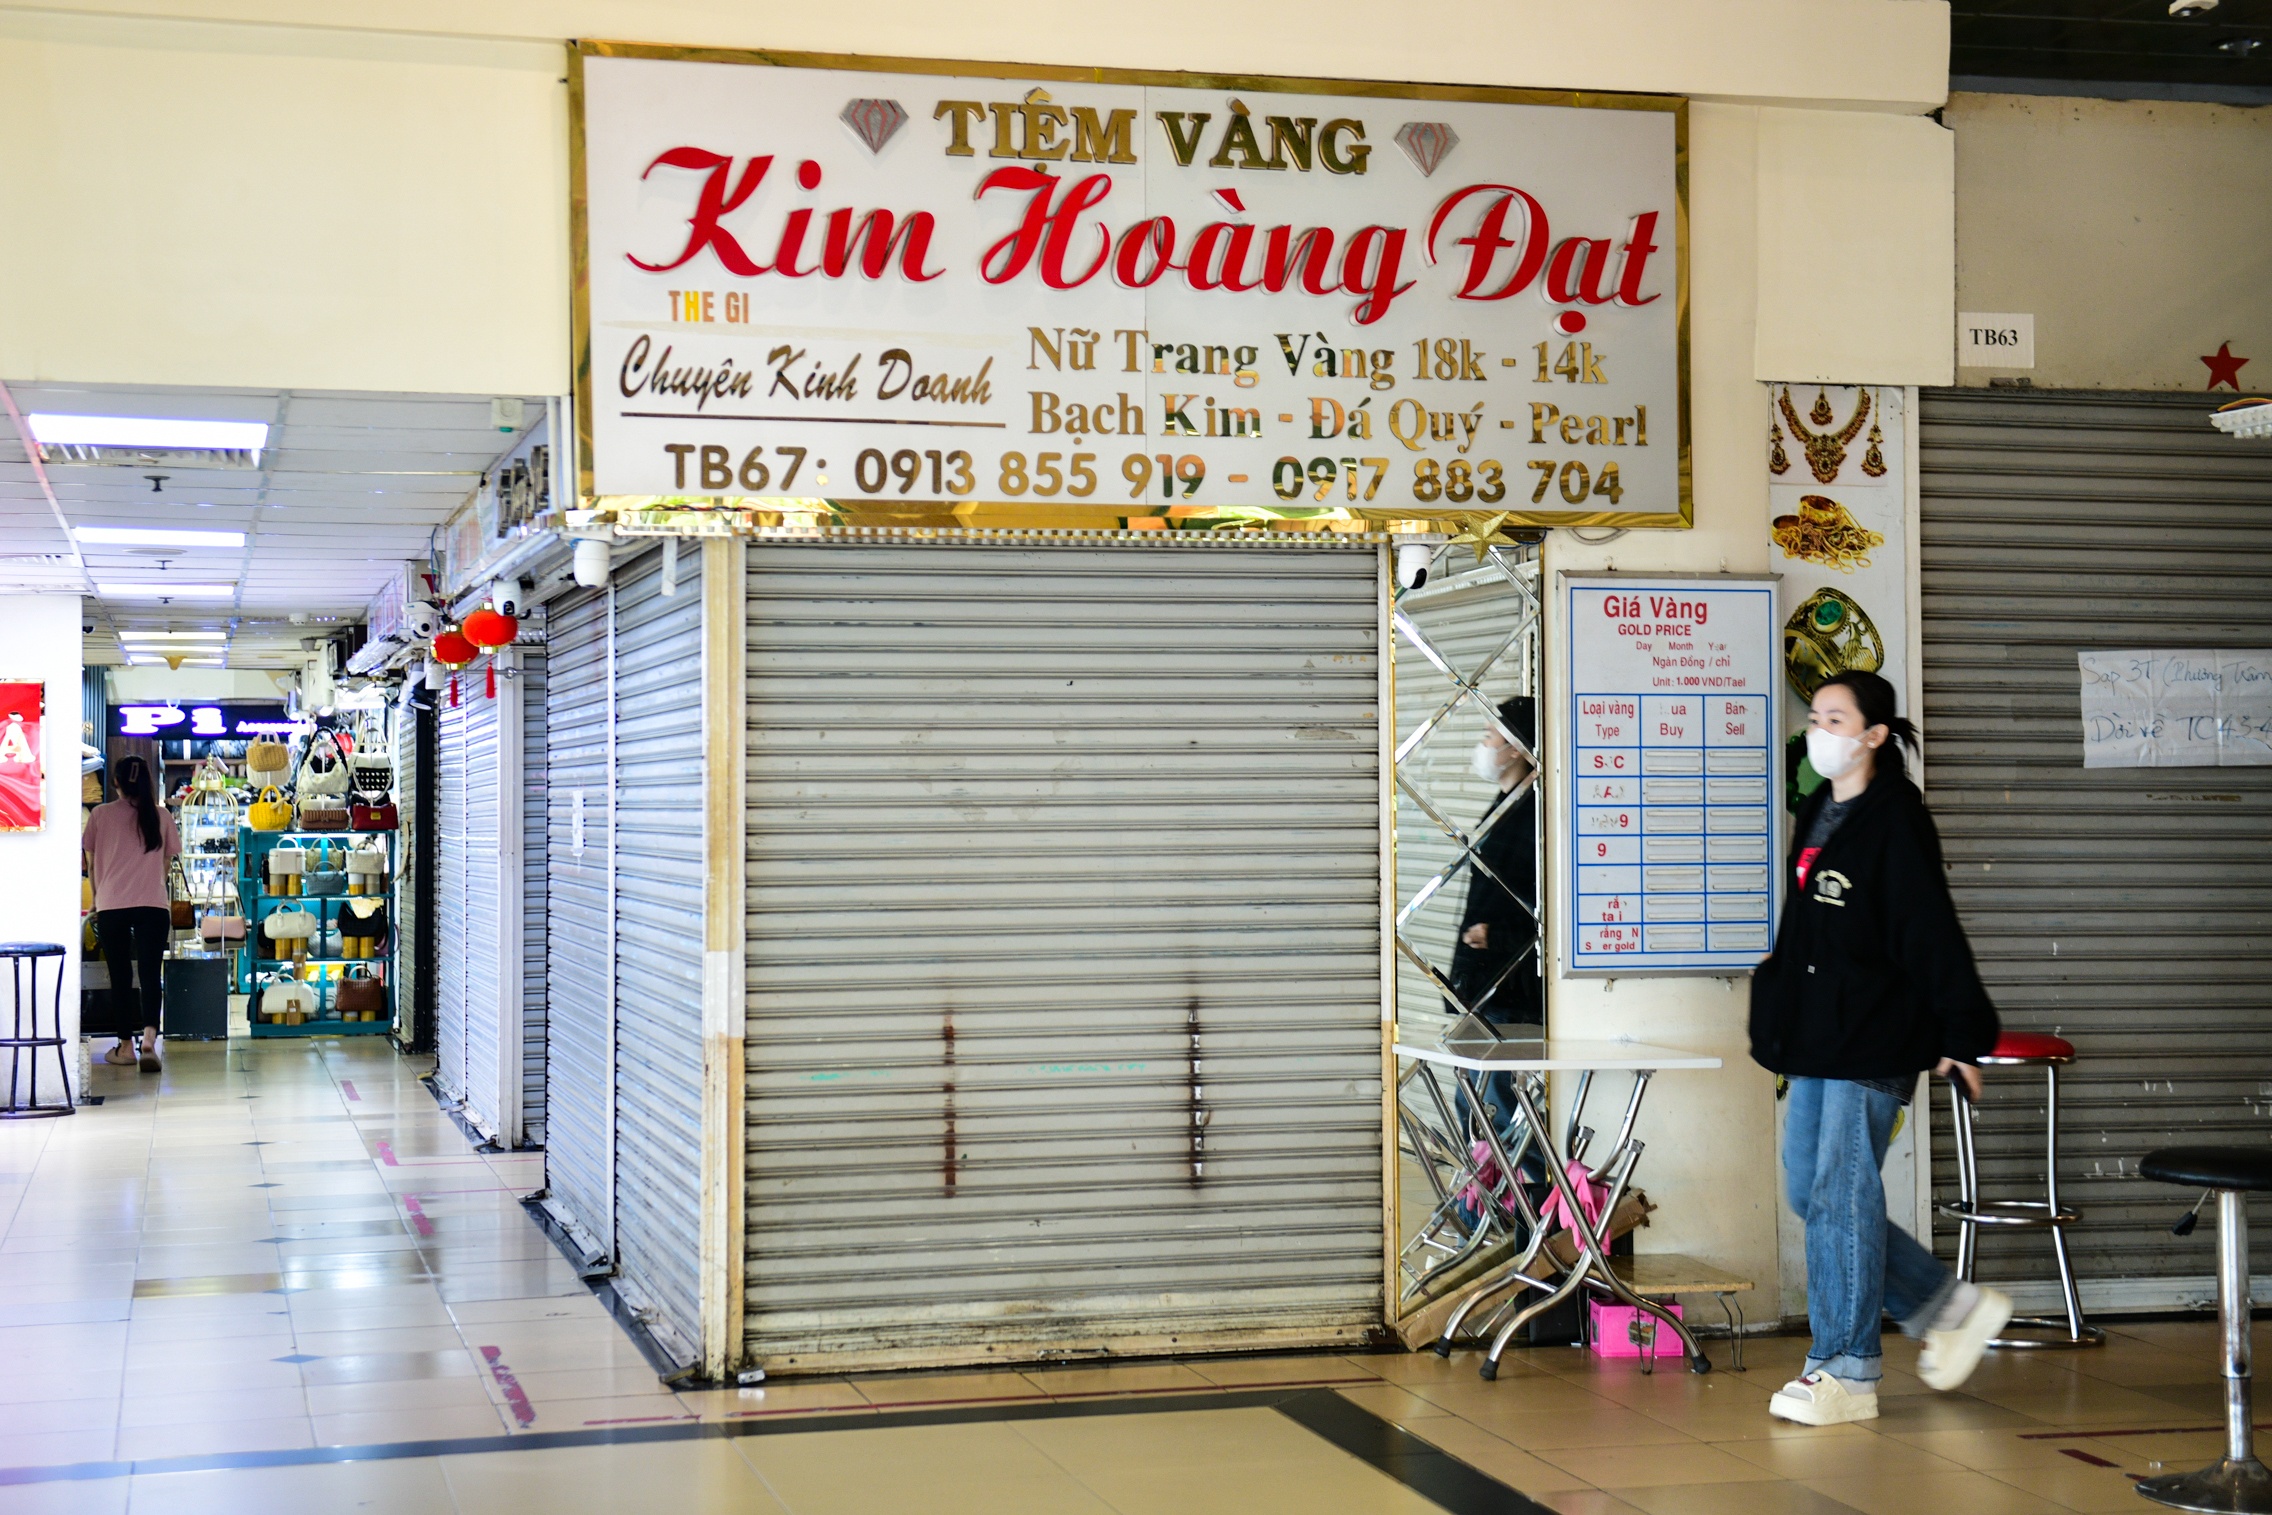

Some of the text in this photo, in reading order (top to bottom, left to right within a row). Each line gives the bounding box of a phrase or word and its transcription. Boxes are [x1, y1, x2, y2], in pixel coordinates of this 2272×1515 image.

[933, 86, 1372, 175] TIỆM VÀNG
[625, 146, 1662, 336] Kim Hoàng Đạt
[668, 290, 715, 322] THE
[1969, 327, 2019, 347] TB63
[1026, 326, 1609, 391] Nữ Trang Vàng 18k - 14k
[619, 333, 995, 411] Chuyên Kinh Doanh
[1027, 391, 1649, 454] Bạch Kim - Đá Quý - Pearl
[663, 443, 1624, 505] TB67: 0913 855 919 - 0917 883 704
[1603, 595, 1708, 625] Giá Vàng
[1618, 624, 1692, 636] GOLD PRICE
[1635, 641, 1653, 652] Day
[1668, 641, 1694, 651] Month
[1652, 656, 1678, 669] Ngàn
[1680, 654, 1705, 669] Đồng
[1676, 676, 1700, 686] 1.000
[1701, 677, 1746, 687] VND/Tael
[1582, 700, 1635, 719] Loại vàng
[1595, 723, 1620, 739] Type
[1659, 722, 1684, 738] Buy
[1725, 722, 1745, 736] Sell
[1614, 941, 1636, 953] gold
